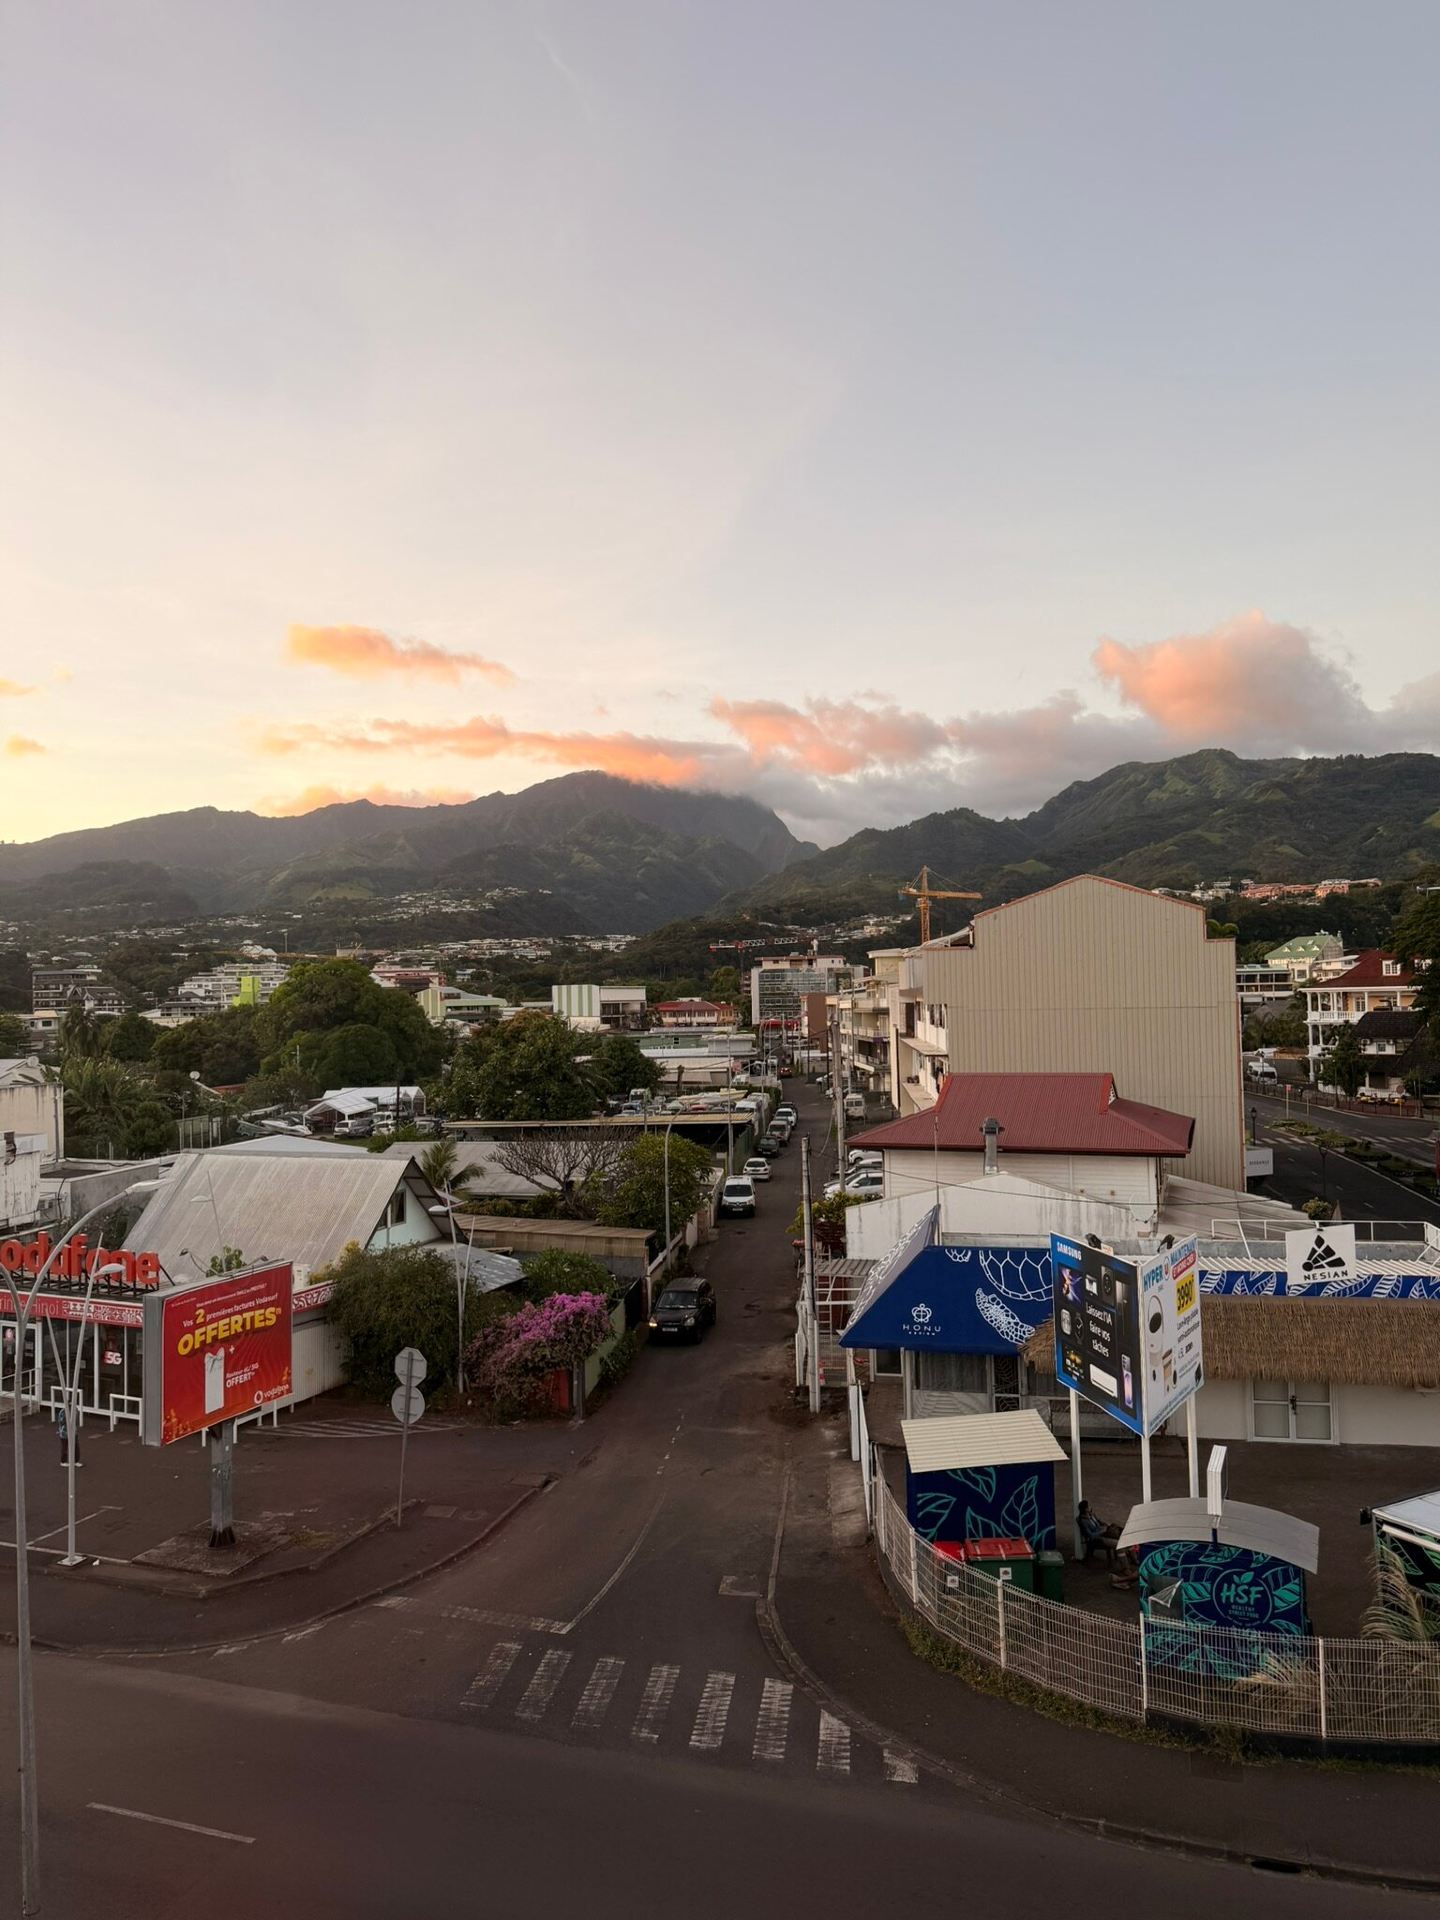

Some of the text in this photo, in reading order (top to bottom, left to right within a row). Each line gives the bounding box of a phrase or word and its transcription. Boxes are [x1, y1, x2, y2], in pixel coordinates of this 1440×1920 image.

[1056, 1241, 1083, 1262] SAMSUNG
[1143, 1264, 1164, 1293] HYPER
[1303, 1269, 1349, 1282] NESIAN
[182, 1319, 194, 1328] Vos
[195, 1308, 206, 1325] 2
[206, 1305, 234, 1322] premières
[234, 1300, 256, 1314] factures
[1085, 1300, 1104, 1323] Laissez
[177, 1306, 277, 1356] OFFERTES
[902, 1324, 941, 1332] HONU
[1088, 1319, 1111, 1343] faire vos
[104, 1350, 123, 1365] 5G
[1092, 1339, 1110, 1358] tâches
[1220, 1582, 1265, 1606] HSF
